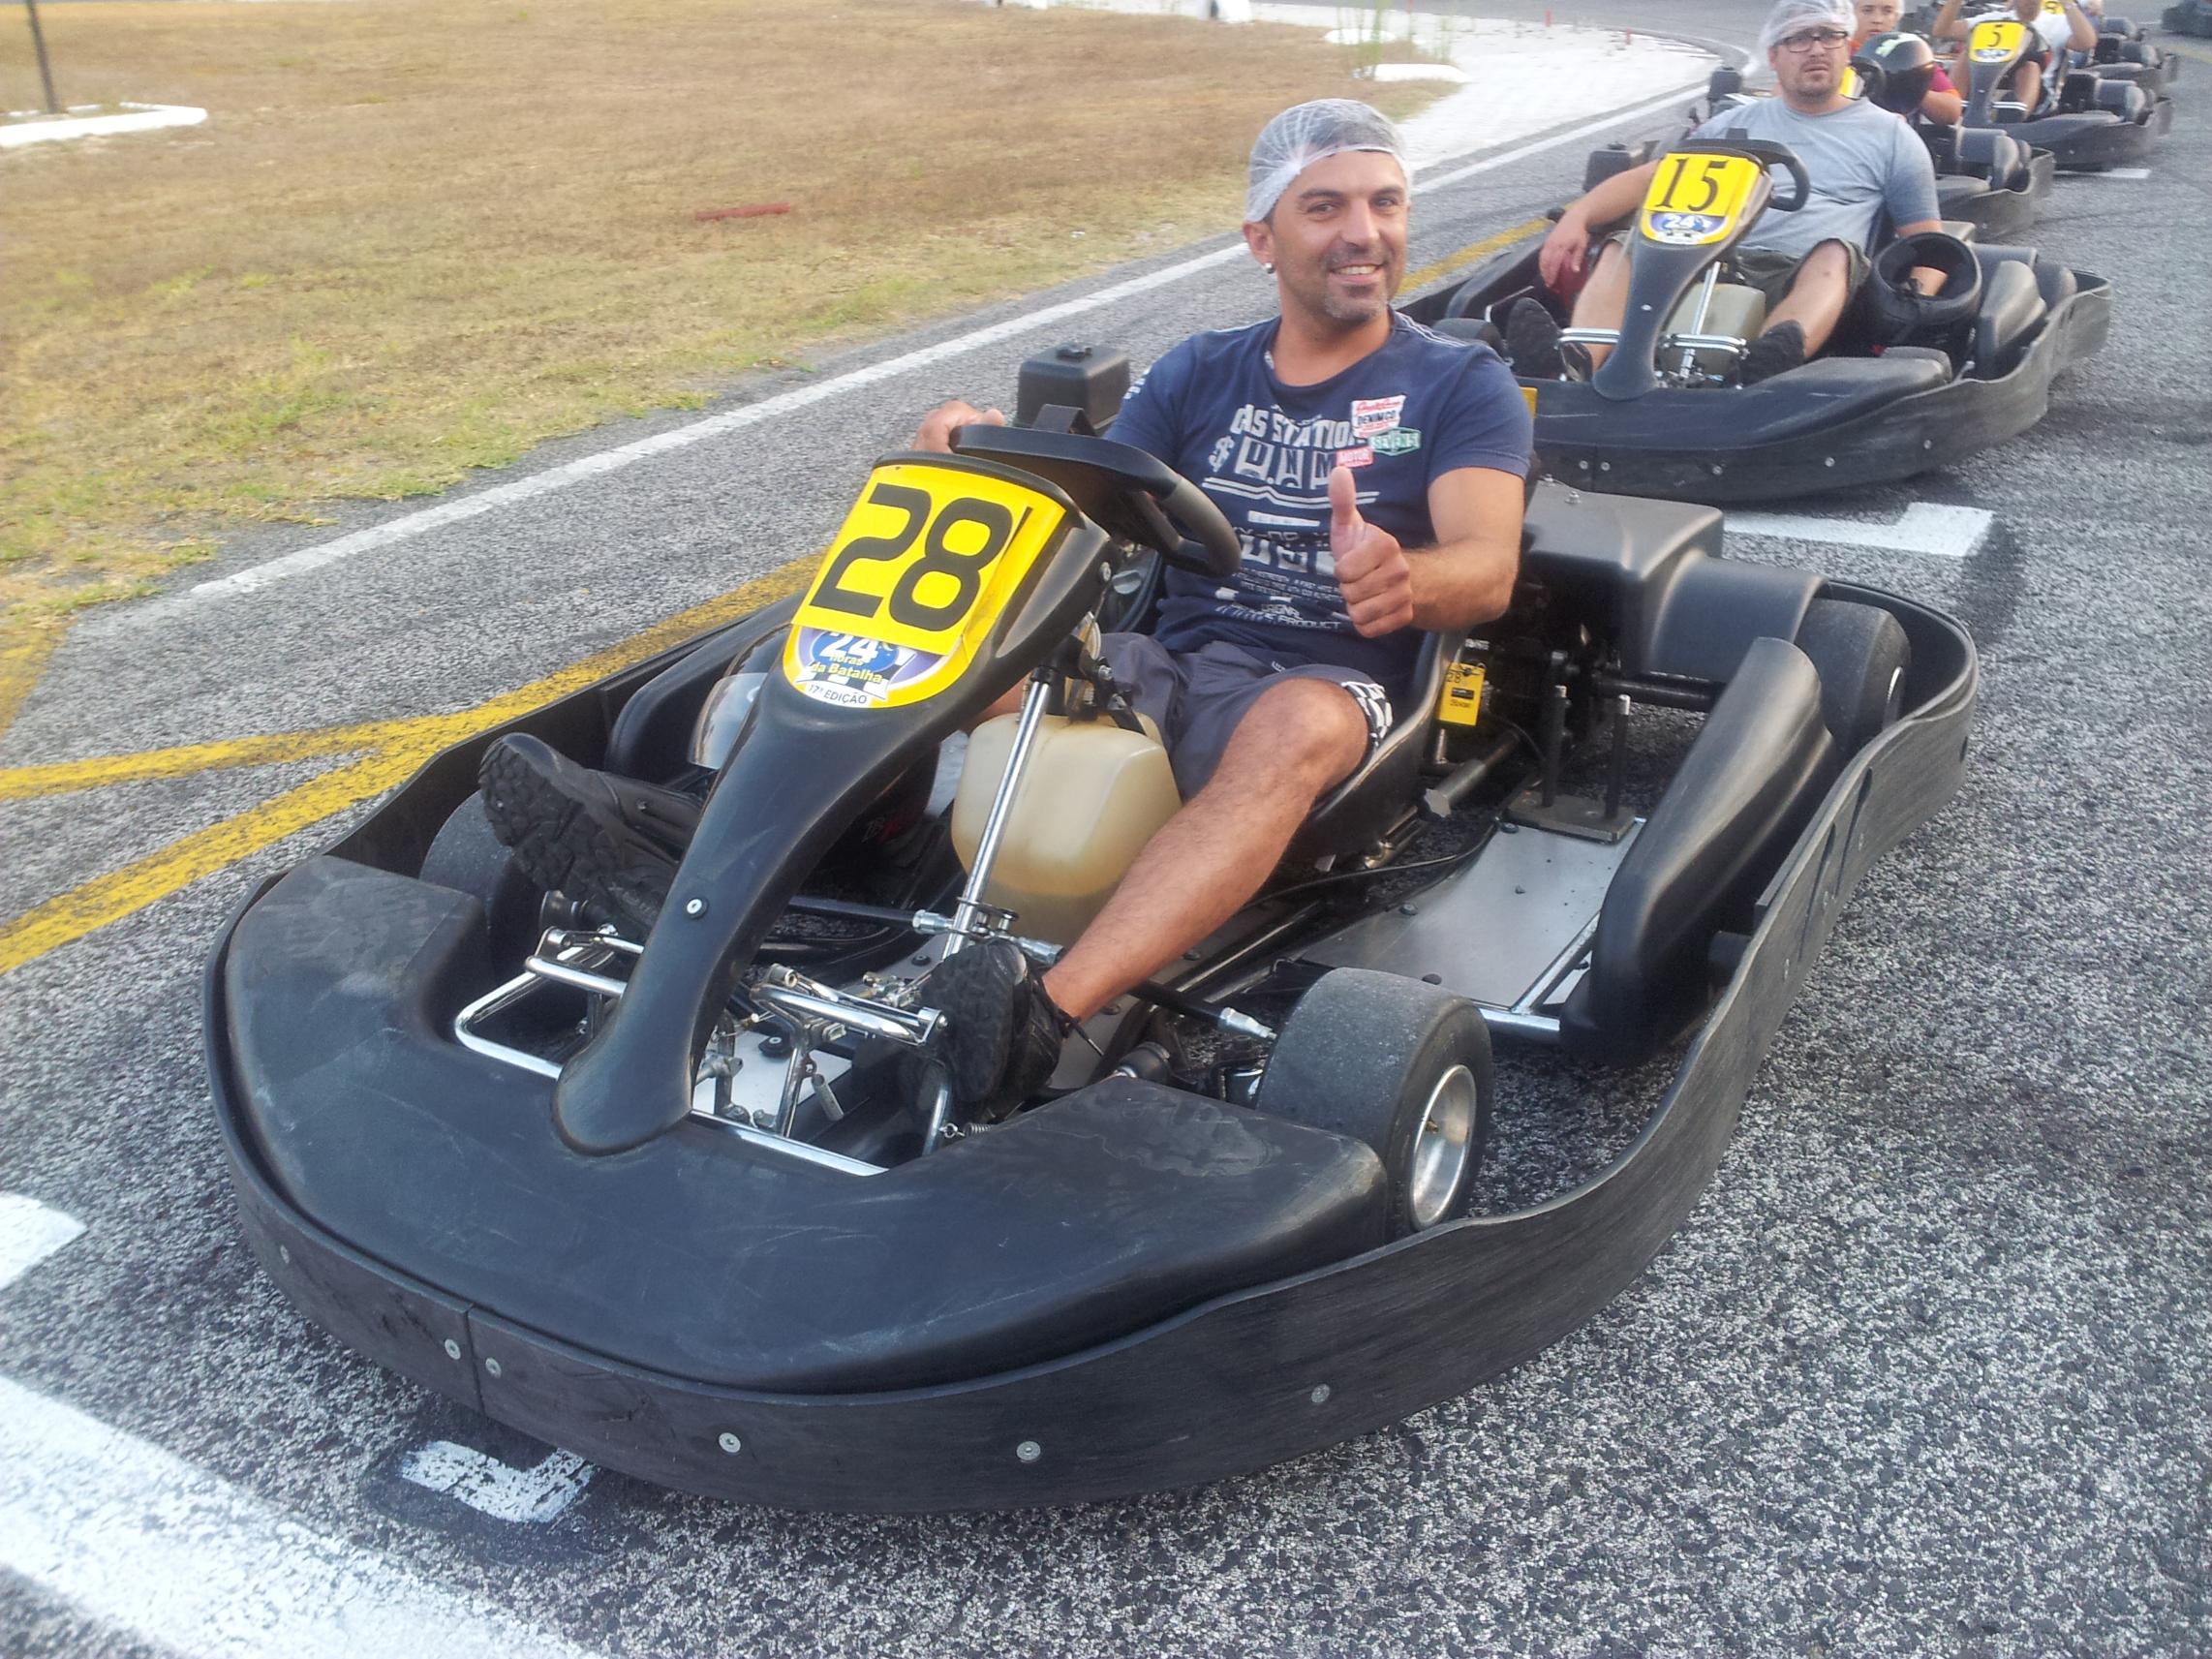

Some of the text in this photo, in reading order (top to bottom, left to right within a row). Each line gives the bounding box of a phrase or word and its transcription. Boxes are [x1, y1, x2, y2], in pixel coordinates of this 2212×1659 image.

[1987, 23, 2004, 47] 5
[1654, 157, 1730, 212] 15
[1271, 413, 1354, 450] STATIO
[809, 481, 1013, 632] 28
[818, 631, 879, 663] 24
[827, 662, 883, 684] Batalha
[823, 688, 869, 705] EDIÇÃO
